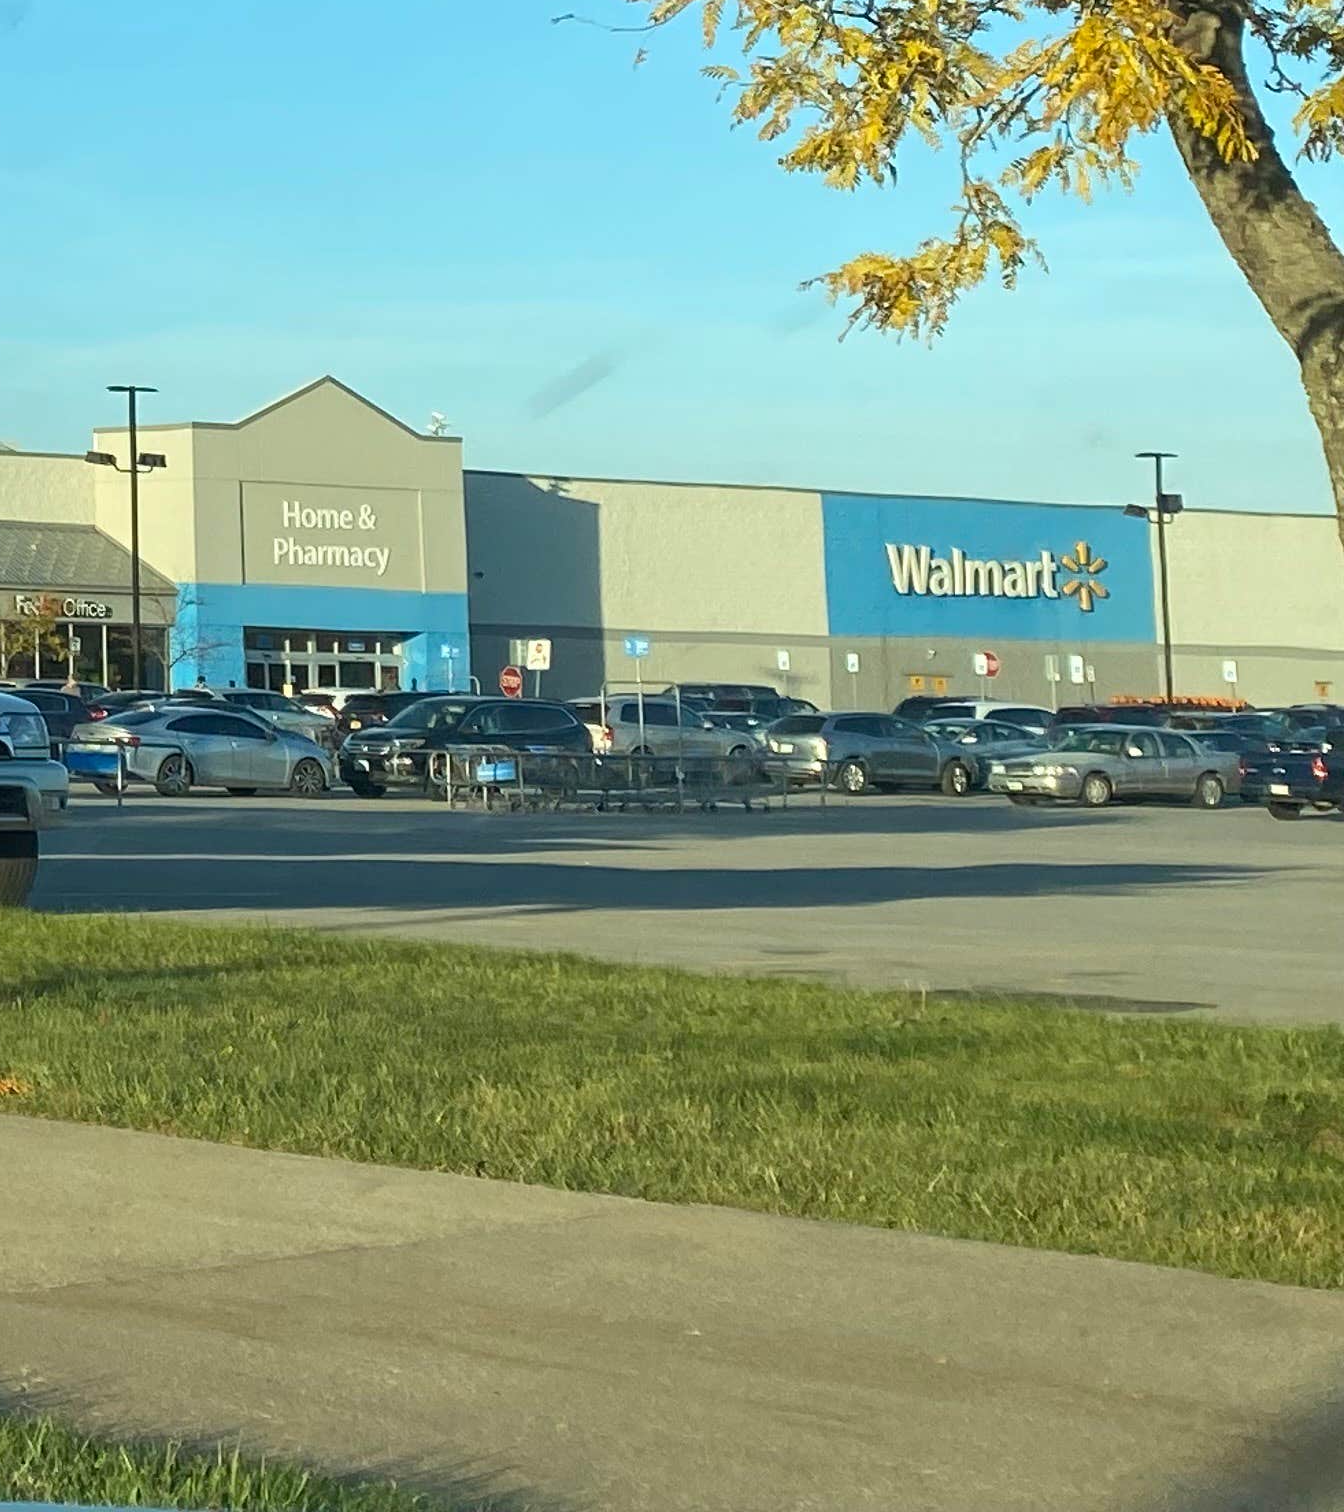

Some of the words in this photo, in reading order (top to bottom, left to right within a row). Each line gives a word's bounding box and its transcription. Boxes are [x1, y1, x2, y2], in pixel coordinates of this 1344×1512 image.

[282, 500, 354, 529] Home
[358, 503, 377, 529] &
[273, 537, 391, 576] Pharmacy
[885, 542, 1060, 599] Walmart
